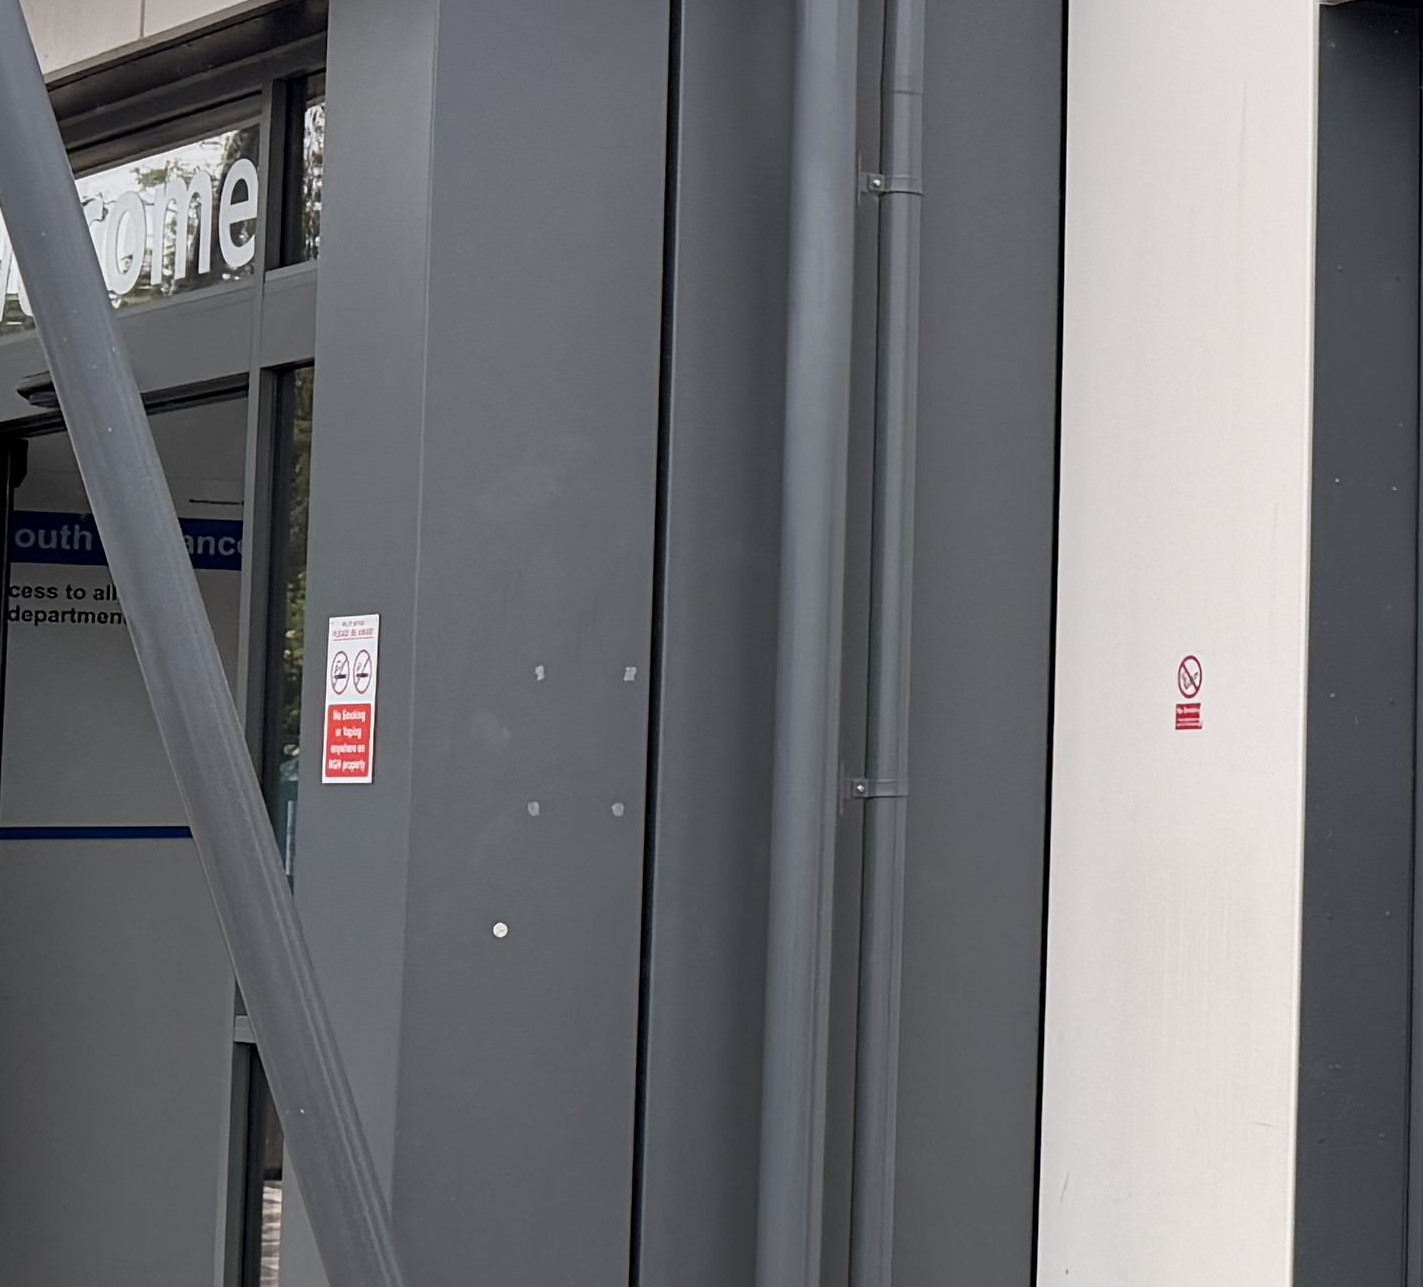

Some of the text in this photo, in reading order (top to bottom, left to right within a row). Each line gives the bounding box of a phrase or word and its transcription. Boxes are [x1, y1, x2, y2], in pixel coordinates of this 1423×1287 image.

[14, 523, 93, 551] outh
[9, 583, 117, 601] cess to all
[8, 605, 126, 626] departmen
